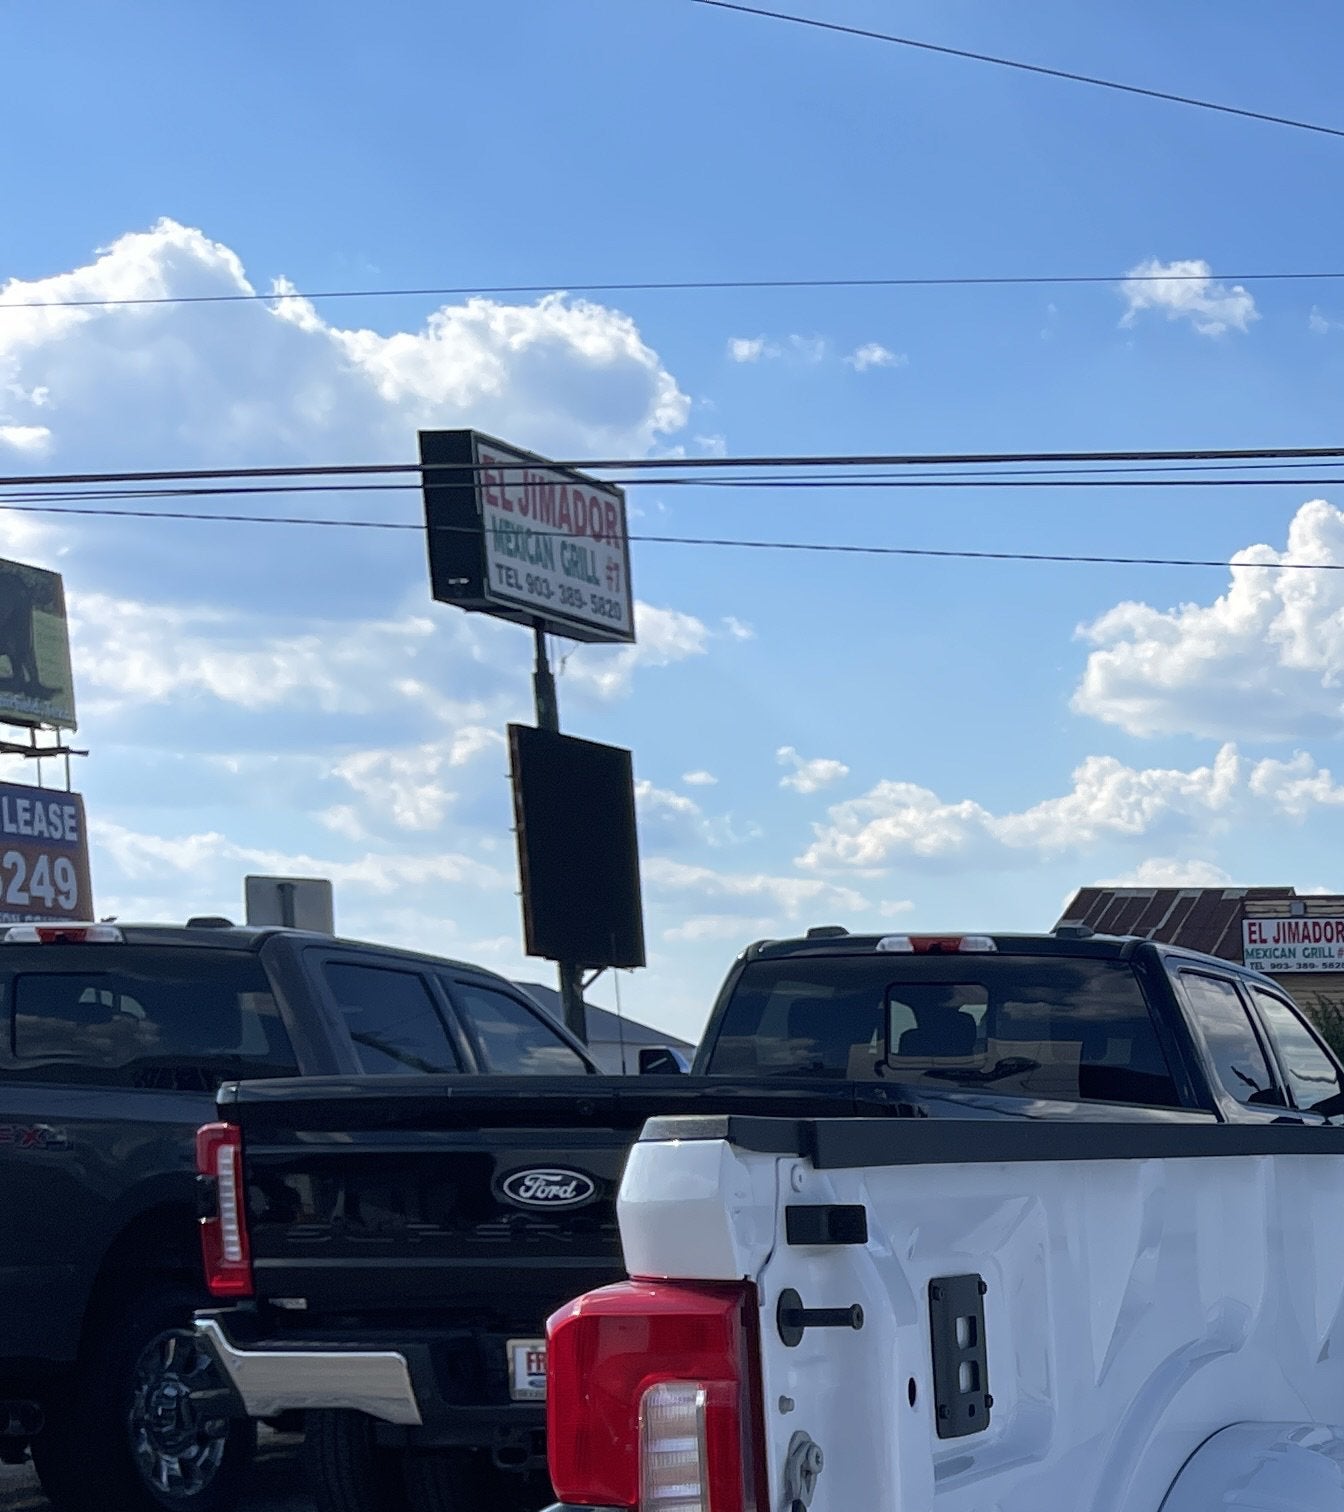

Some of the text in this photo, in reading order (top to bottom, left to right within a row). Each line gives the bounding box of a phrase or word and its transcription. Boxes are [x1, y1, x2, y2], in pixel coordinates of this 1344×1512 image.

[482, 454, 621, 550] EL JIMADOR
[492, 515, 556, 572] MEXICAN
[560, 540, 602, 587] GRILL
[495, 562, 523, 592] TEL
[2, 795, 78, 842] LEASE
[0, 849, 78, 911] 249
[1247, 922, 1268, 944] EL
[1245, 947, 1297, 960] MEXICAN
[1302, 947, 1335, 959] GRILL
[1250, 961, 1265, 970] TEL
[519, 1173, 578, 1200] Ford
